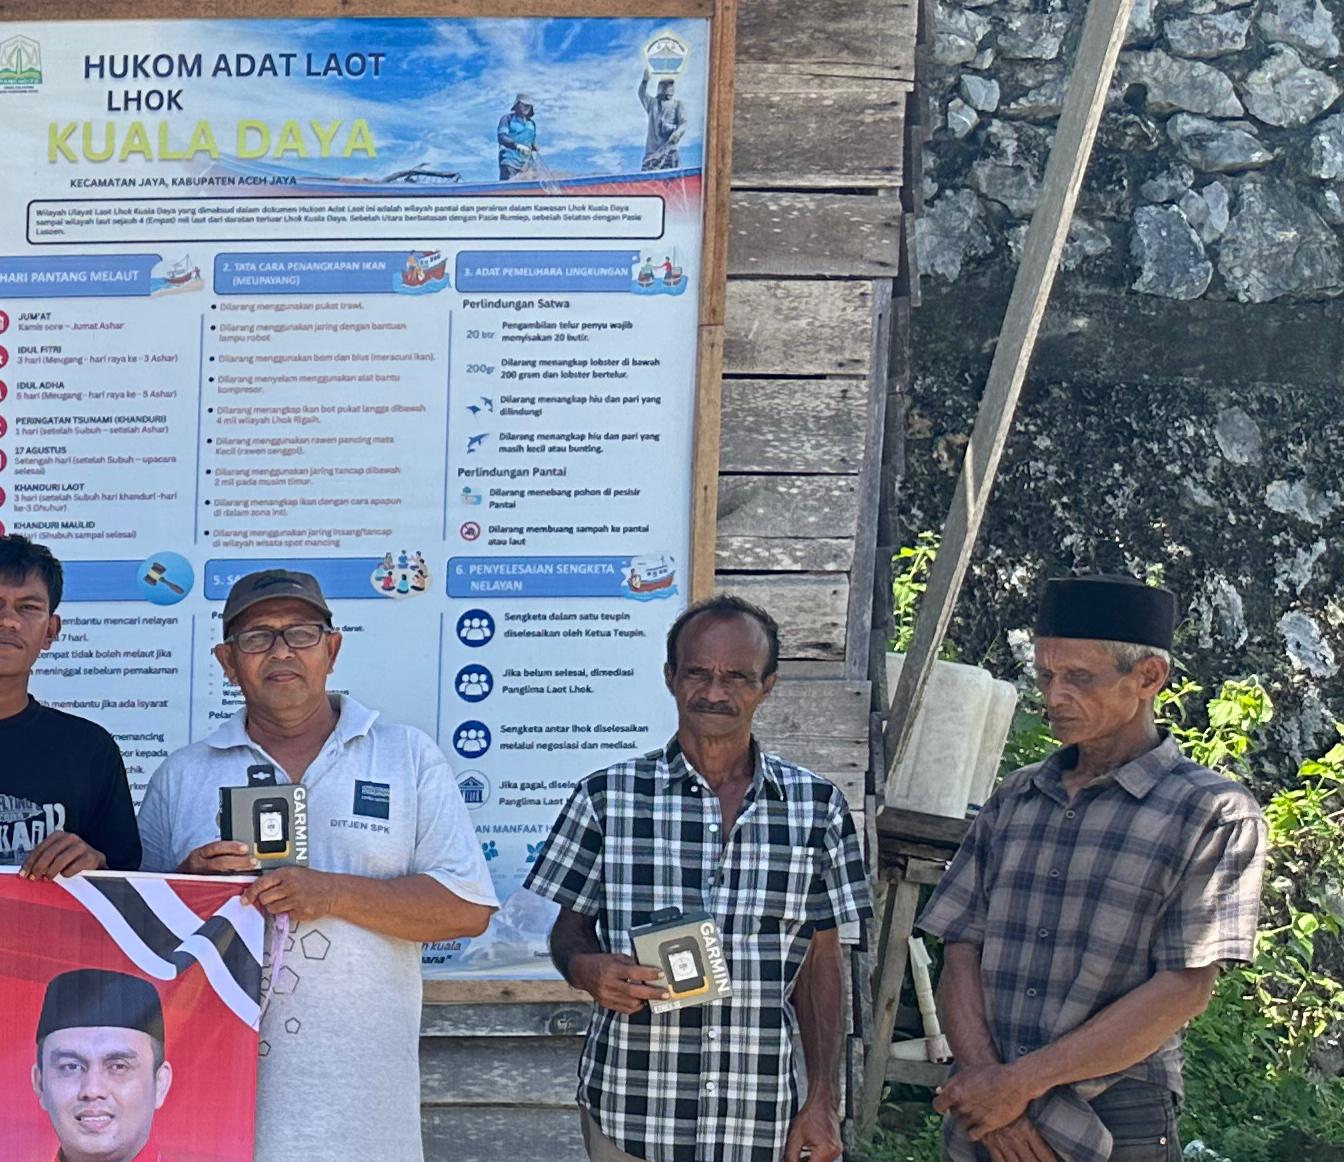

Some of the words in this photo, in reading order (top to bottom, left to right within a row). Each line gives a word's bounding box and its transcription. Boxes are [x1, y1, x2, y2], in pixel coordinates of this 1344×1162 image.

[84, 53, 202, 79] HUKOM
[211, 53, 296, 77] ADAT
[305, 52, 386, 77] LAOT
[107, 89, 183, 112] LHOK
[47, 120, 220, 163] KUALA
[236, 119, 377, 159] DAYA
[70, 177, 137, 189] KECAMATAN
[138, 177, 169, 188] JAYA,
[171, 176, 235, 187] KABUPATEN
[238, 176, 267, 186] ACEH
[269, 176, 297, 186] JAYA
[223, 263, 231, 271] 2.
[235, 262, 257, 271] TATA
[259, 262, 285, 271] CARA
[287, 261, 360, 271] PENANGKAPAN
[362, 262, 387, 270] IKAN
[0, 273, 29, 283] HARI
[31, 271, 87, 283] PANTANG
[90, 270, 139, 281] MELAUT
[476, 268, 500, 276] ADAT
[503, 268, 562, 276] PEMELIHARA
[566, 268, 629, 276] LINGKUNGAN
[233, 276, 300, 286] (MEUPAYANG)
[462, 299, 534, 311] Perlindungan
[538, 299, 570, 309] Satwa
[502, 321, 556, 330] Pengambilan
[581, 322, 608, 331] penyu
[610, 321, 633, 330] wajib
[466, 330, 480, 339] 20
[502, 334, 553, 343] menyisakan
[554, 334, 565, 342] 20
[466, 364, 495, 375] 200gr
[17, 382, 38, 390] IDUL
[15, 417, 71, 425] PERINGATAN
[73, 416, 113, 424] TSUNAMI
[457, 468, 529, 479] Perlindungan
[532, 467, 567, 477] Pantai
[489, 488, 525, 498] Dilarang
[527, 488, 572, 498] menebang
[574, 488, 601, 498] pohon
[603, 488, 611, 496] di
[61, 521, 95, 529] MAULID
[456, 566, 465, 575] 6.
[469, 564, 554, 575] PENYELESAIAN
[556, 564, 615, 575] SENGKETA
[470, 581, 523, 591] NELAYAN
[103, 616, 141, 625] mencari
[142, 616, 178, 627] nelayan
[504, 612, 547, 622] Sengketa
[549, 612, 578, 621] dalam
[579, 613, 599, 621] satu
[600, 612, 631, 622] teupin
[504, 629, 561, 638] diselesaikan
[562, 629, 583, 638] oleh
[585, 629, 612, 638] Ketua
[613, 629, 647, 640] Teupin.
[502, 668, 522, 677] Jika
[523, 668, 553, 677] belum
[554, 668, 589, 679] selesai,
[590, 668, 634, 677] dimediasi
[502, 685, 545, 696] Panglima
[546, 685, 567, 694] Laot
[569, 685, 595, 694] Lhok.
[500, 724, 543, 734] Sengketa
[544, 725, 570, 733] antar
[593, 724, 649, 733] diselesaikan
[499, 741, 534, 750] melalui
[536, 741, 579, 752] negosiasi
[581, 741, 599, 749] dan
[600, 741, 637, 749] mediasi.
[499, 781, 518, 789] Jika
[499, 797, 541, 808] Panglima
[543, 797, 563, 805] Laot
[293, 787, 307, 861] GARMIN
[330, 819, 368, 831] DITJEN
[370, 824, 391, 834] SPK
[493, 824, 543, 833] MANFAAT
[700, 922, 730, 993] GARMIN
